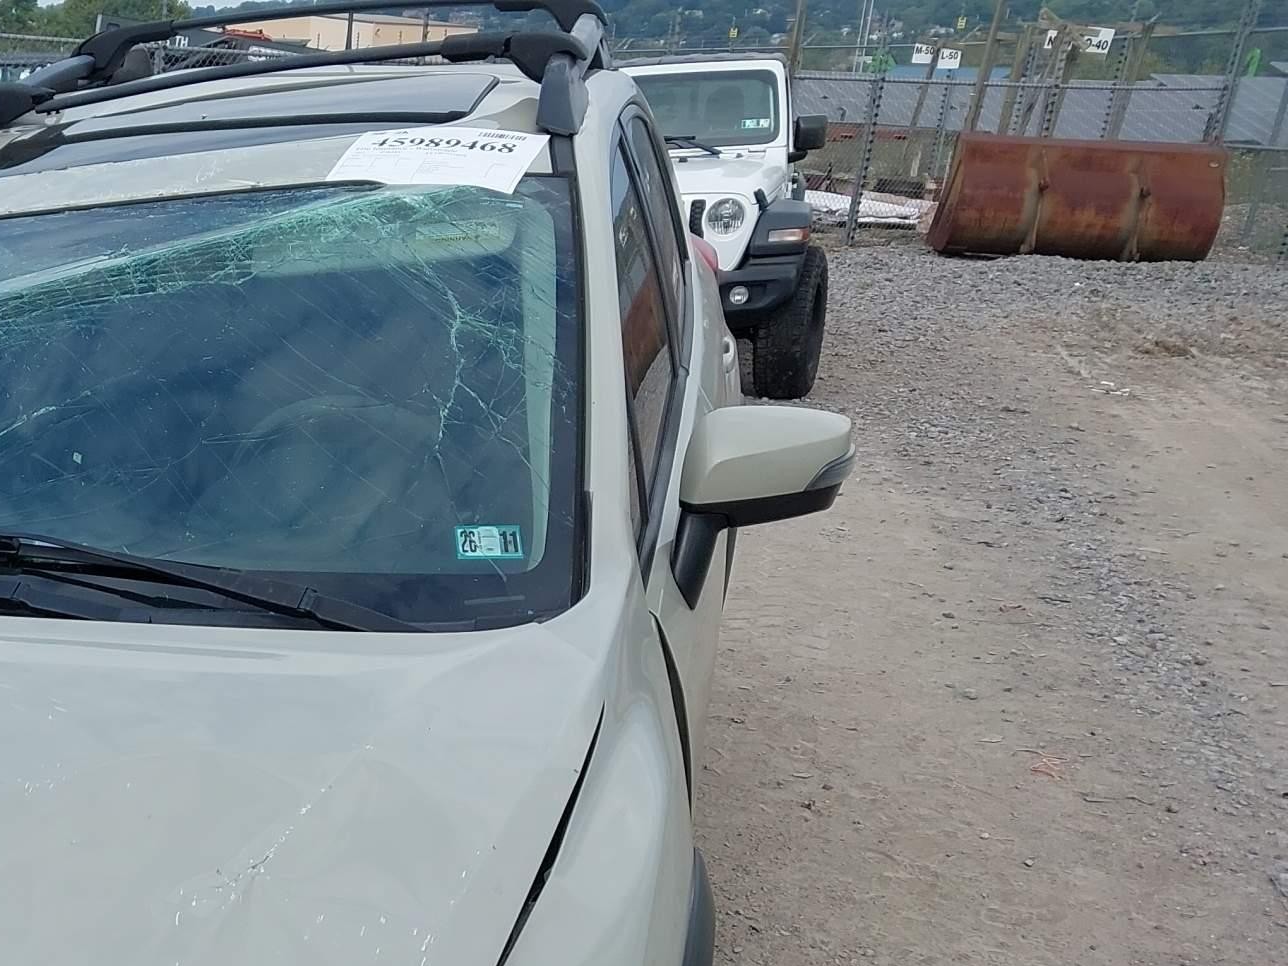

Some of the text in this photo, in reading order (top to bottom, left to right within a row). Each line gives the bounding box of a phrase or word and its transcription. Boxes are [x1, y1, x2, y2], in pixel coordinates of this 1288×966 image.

[941, 51, 959, 60] L-50
[372, 137, 517, 154] 45989468
[460, 530, 519, 553] 26 11
